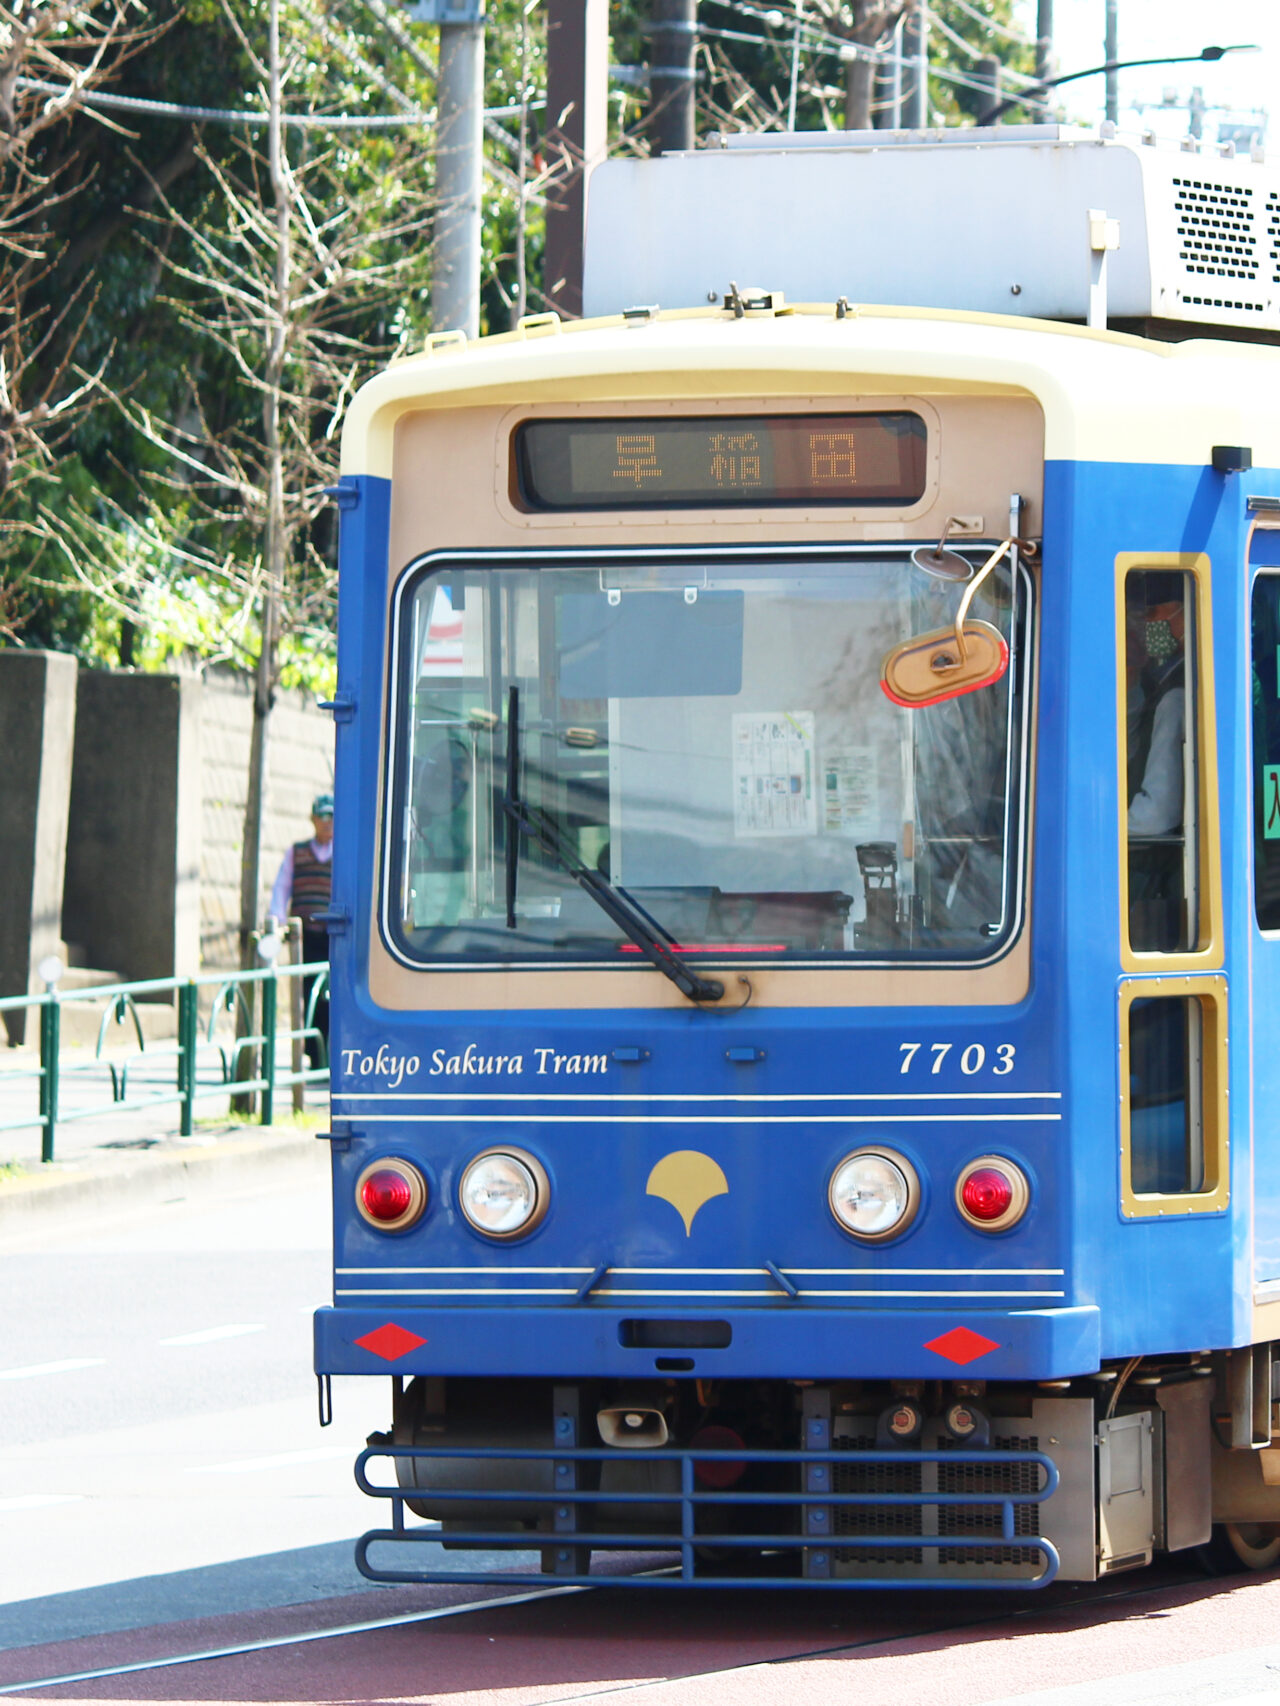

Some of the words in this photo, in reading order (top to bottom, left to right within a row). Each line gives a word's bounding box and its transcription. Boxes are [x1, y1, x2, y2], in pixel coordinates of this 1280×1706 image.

[612, 433, 862, 489] 早稲田
[341, 1044, 420, 1088] Tokyo
[429, 1044, 523, 1075] Sakura
[533, 1048, 608, 1074] Tram
[899, 1042, 1016, 1075] 7703
